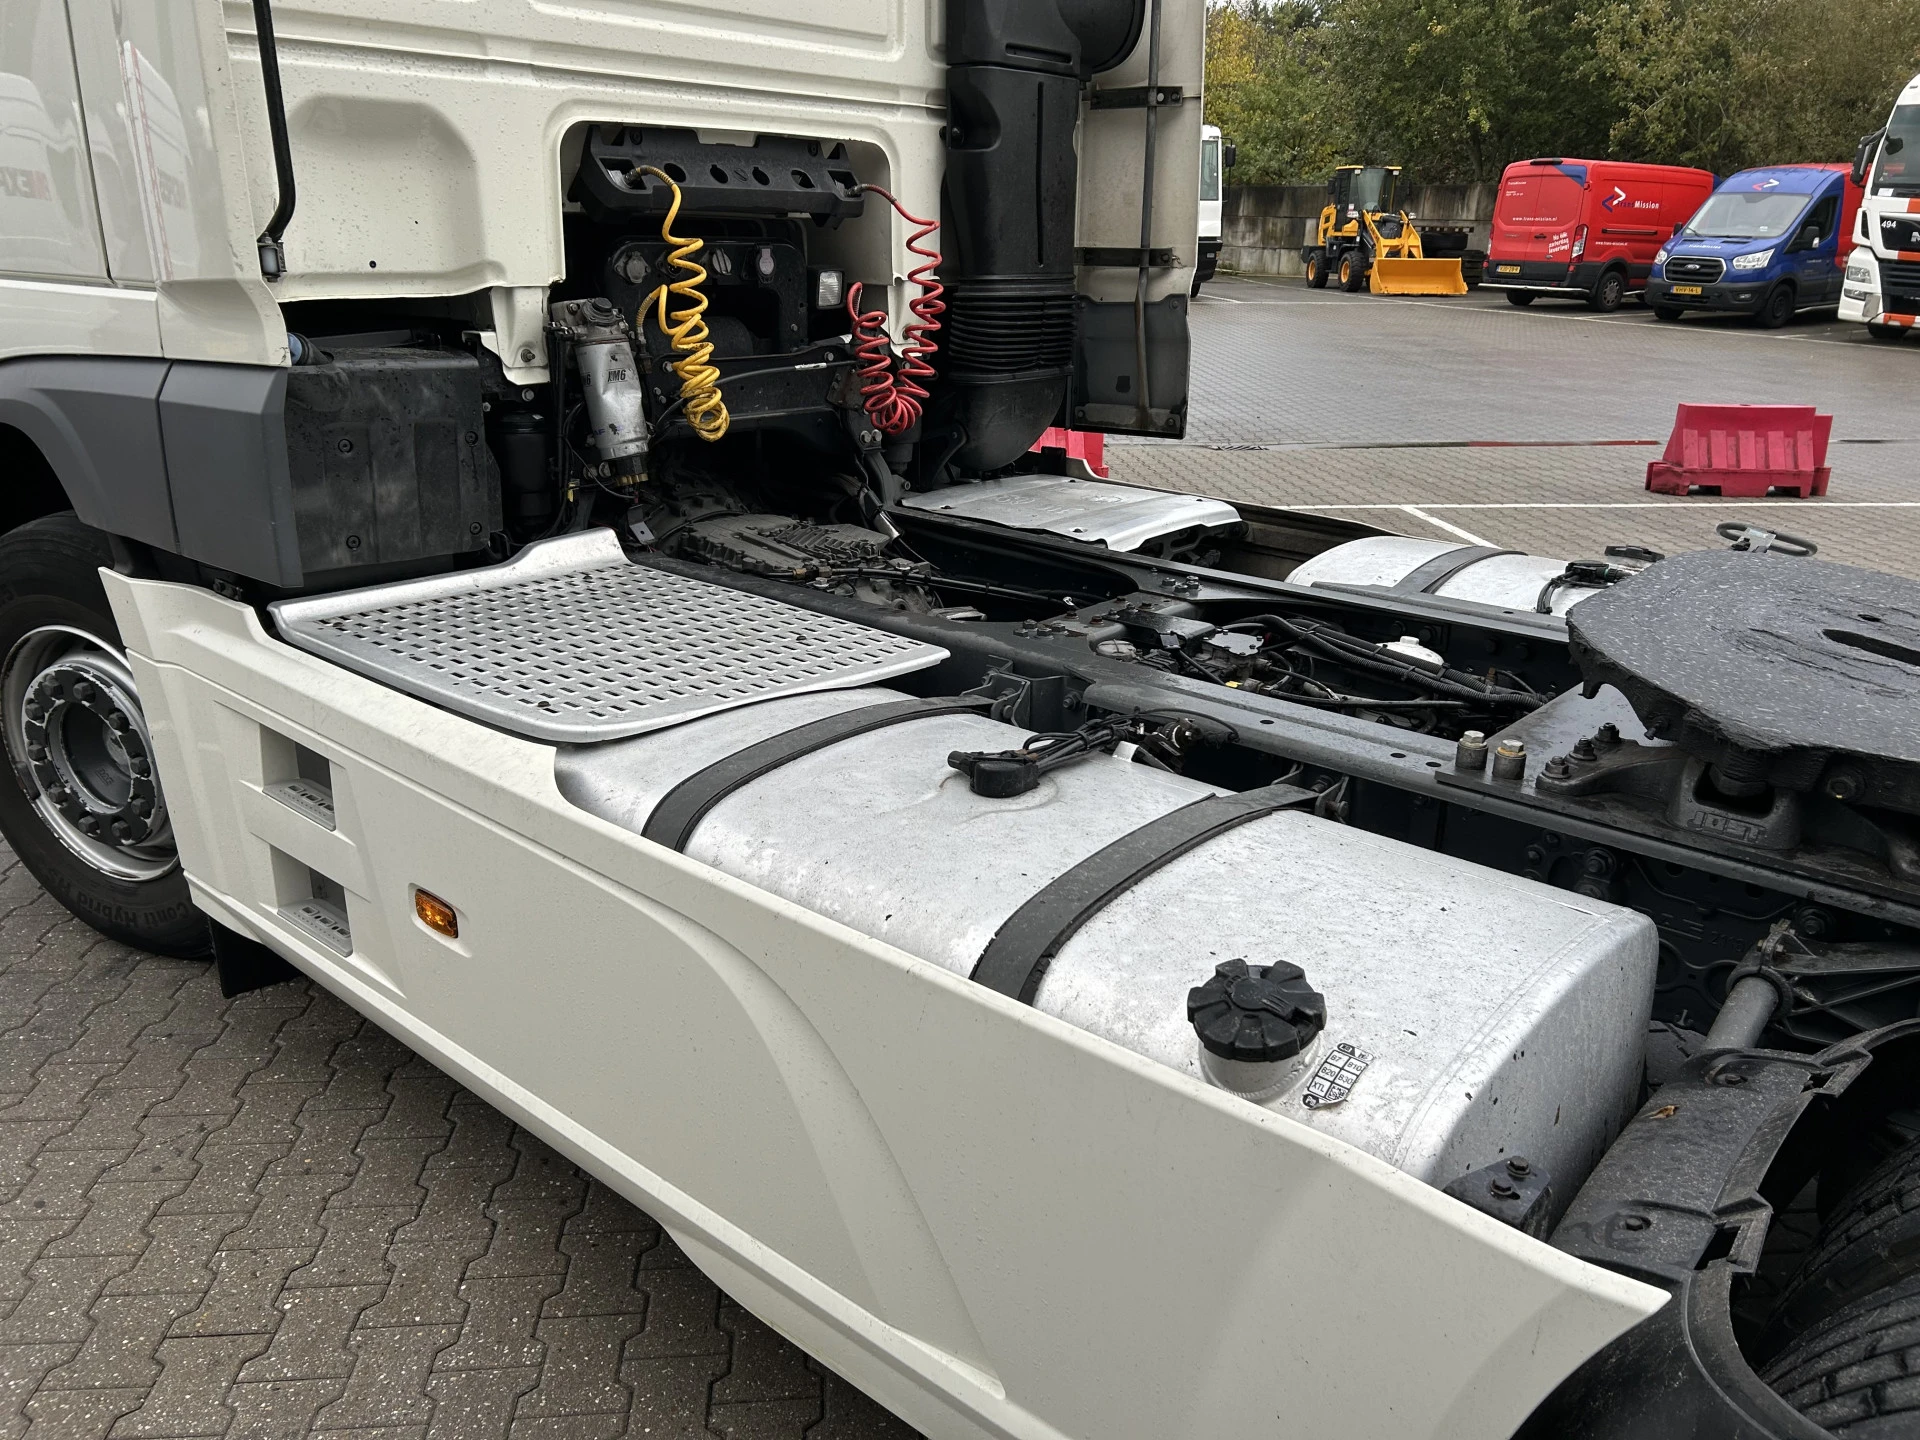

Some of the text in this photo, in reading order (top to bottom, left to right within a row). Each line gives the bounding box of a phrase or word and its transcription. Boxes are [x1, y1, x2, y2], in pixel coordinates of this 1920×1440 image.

[1881, 220, 1897, 229] 494
[1330, 1054, 1362, 1072] B7 B10
[1321, 1066, 1353, 1085] B20 B30
[1311, 1081, 1325, 1093] XTL
